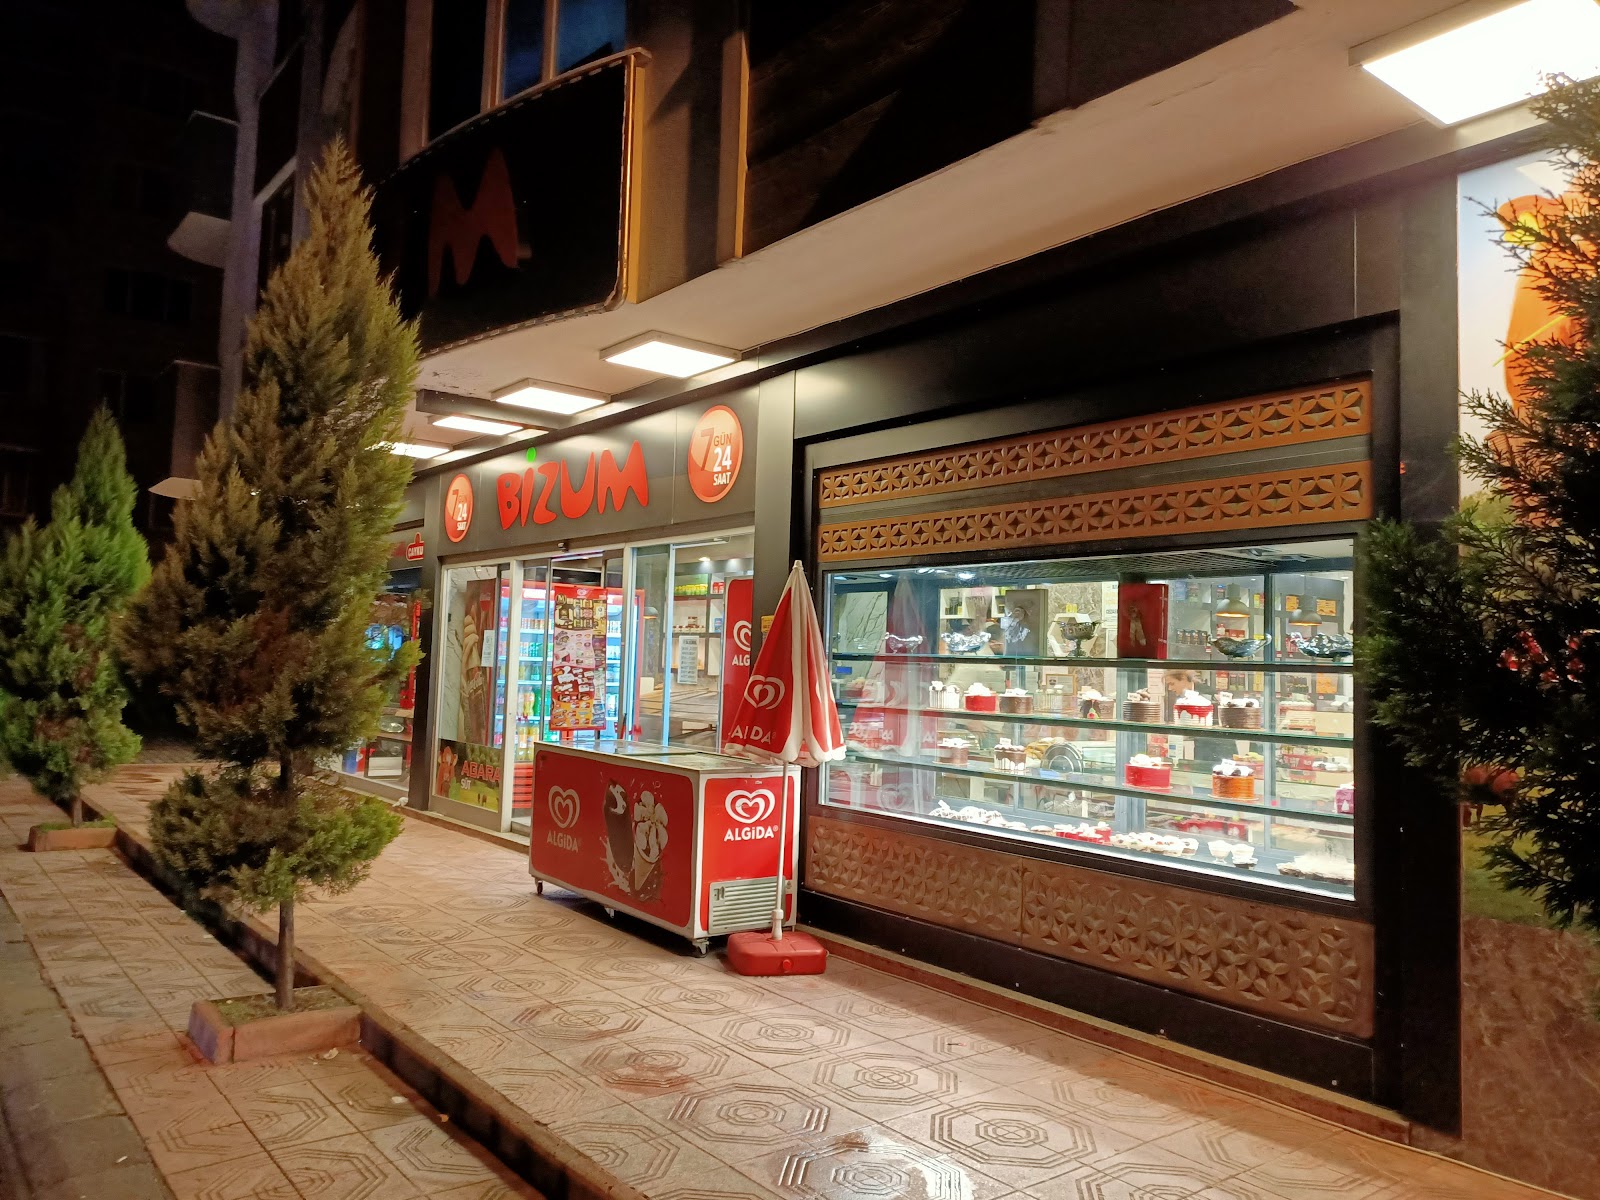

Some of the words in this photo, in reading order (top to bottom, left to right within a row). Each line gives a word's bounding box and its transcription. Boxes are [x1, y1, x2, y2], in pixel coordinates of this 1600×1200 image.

[701, 427, 714, 471] 7
[713, 432, 732, 447] GÜN
[713, 445, 732, 472] 24
[713, 472, 731, 486] SAAT
[457, 503, 467, 522] 24
